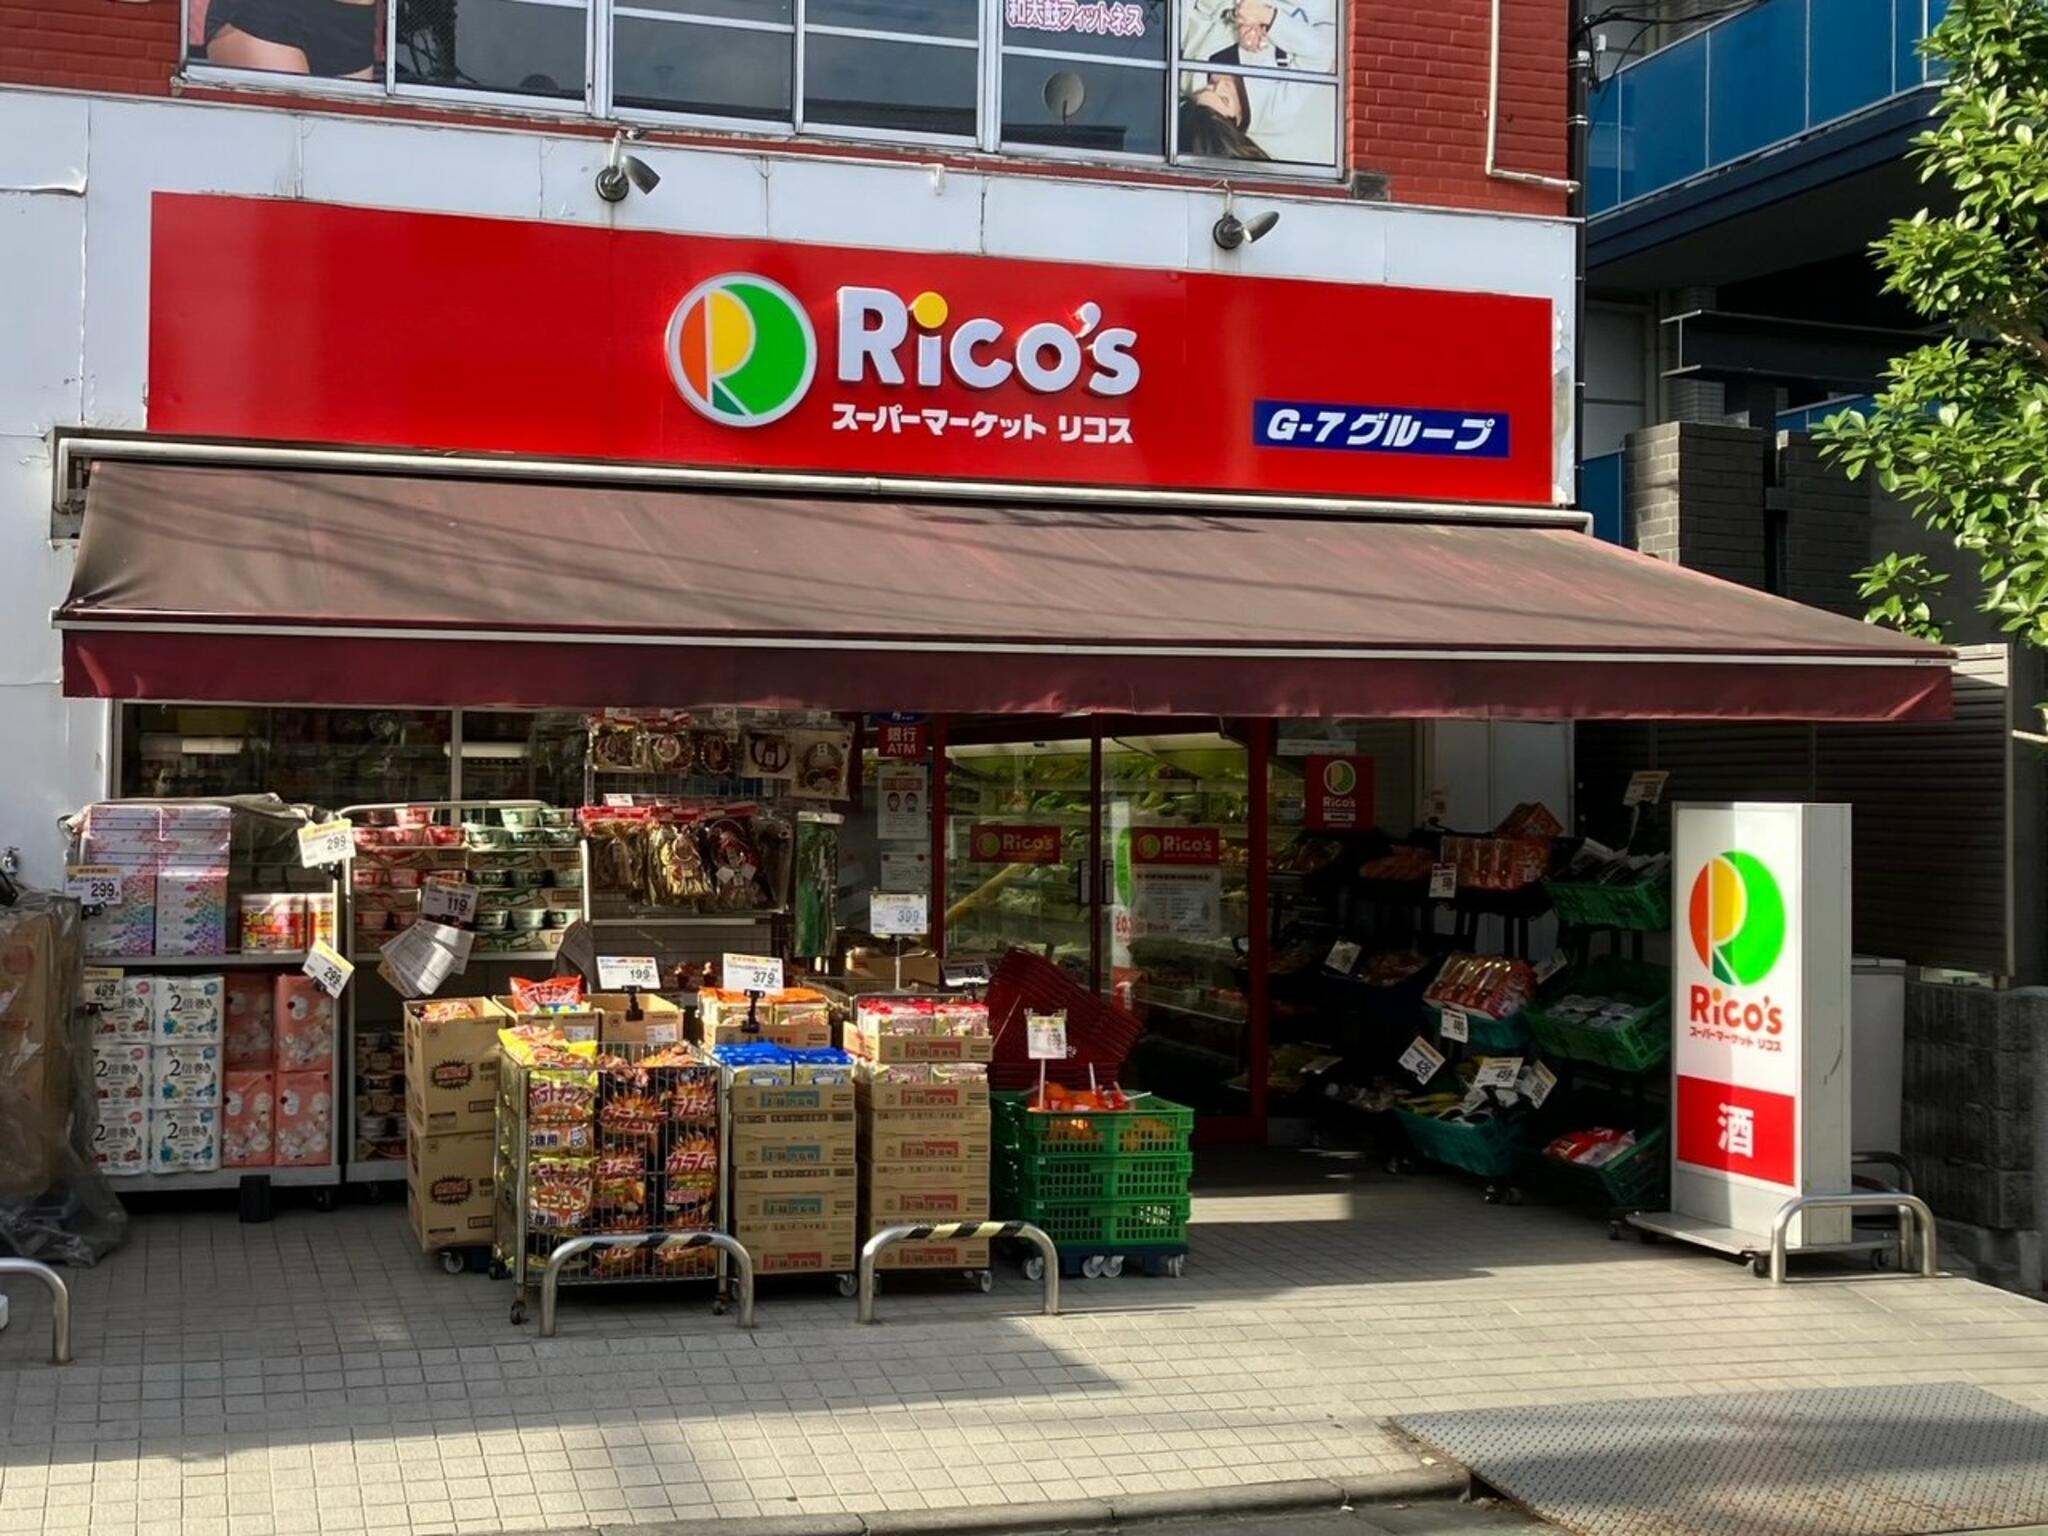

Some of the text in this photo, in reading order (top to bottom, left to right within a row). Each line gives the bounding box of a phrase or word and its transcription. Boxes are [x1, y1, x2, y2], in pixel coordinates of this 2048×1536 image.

[836, 284, 1141, 397] Rico's
[832, 403, 1134, 444] スーパーマーケット リコス
[887, 742, 917, 755] ATM
[1163, 834, 1213, 853] Rico's
[1690, 984, 1783, 1036] Rico's
[1717, 1101, 1755, 1159] 酒
